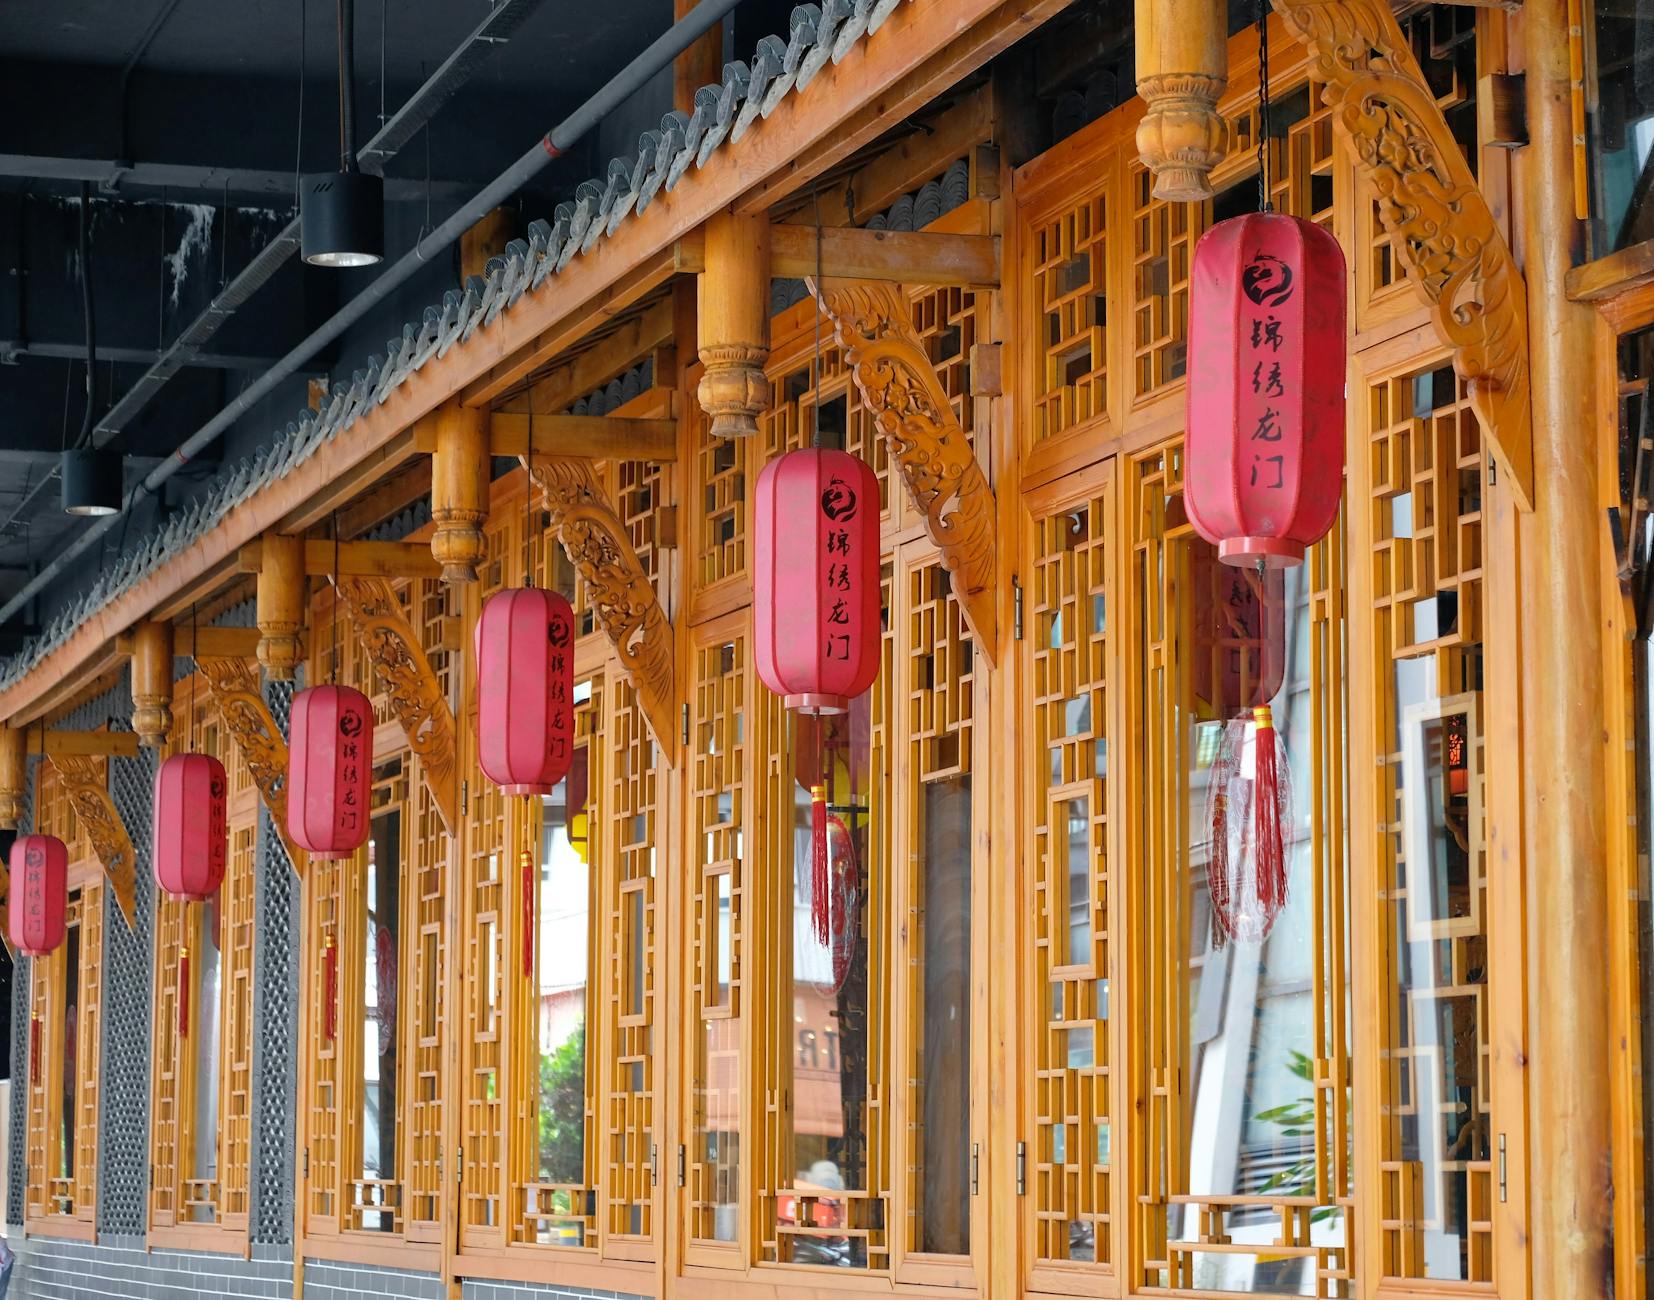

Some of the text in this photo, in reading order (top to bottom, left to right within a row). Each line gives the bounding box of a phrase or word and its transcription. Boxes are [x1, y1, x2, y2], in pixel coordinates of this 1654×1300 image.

[1250, 315, 1284, 489] 锦绣龙门
[826, 528, 851, 660] 锦绣龙门
[550, 653, 565, 759] 锦绣龙门
[341, 742, 358, 830] 锦绣龙门
